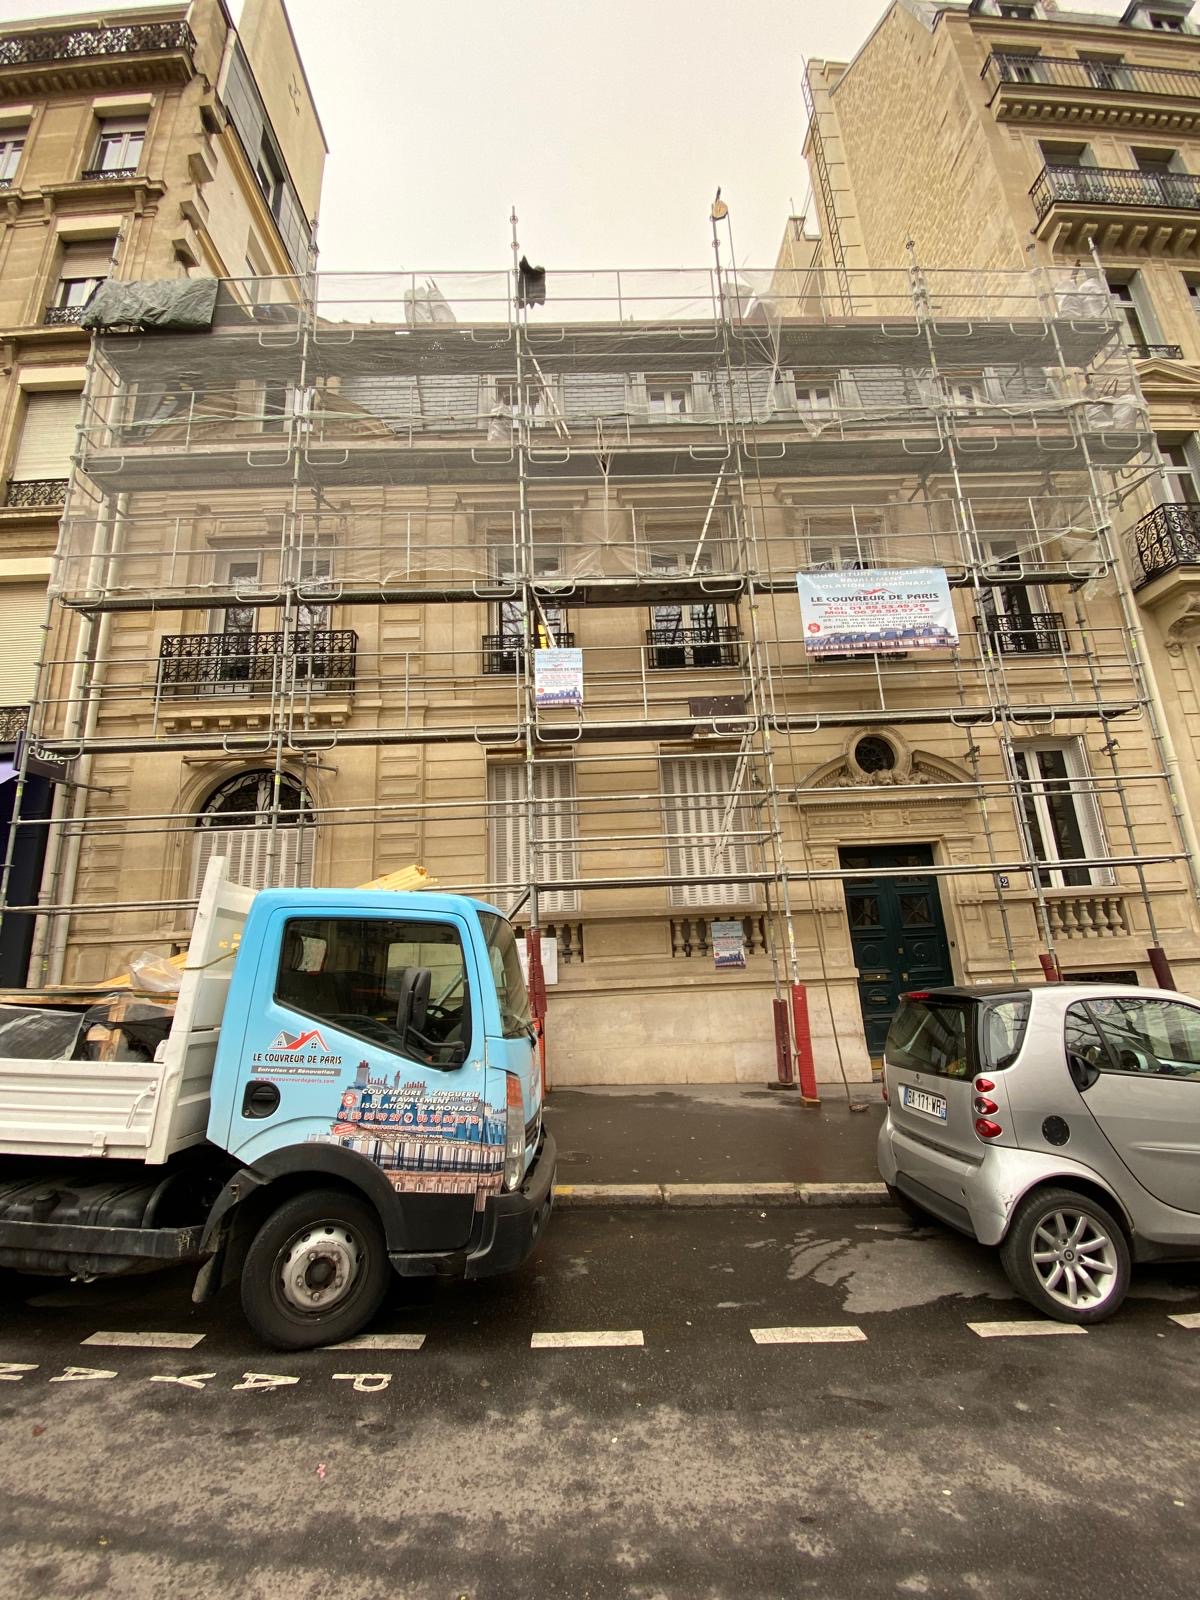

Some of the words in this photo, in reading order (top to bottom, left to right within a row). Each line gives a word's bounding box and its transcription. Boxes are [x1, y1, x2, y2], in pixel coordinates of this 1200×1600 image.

[253, 1053, 261, 1061] LE
[264, 1053, 305, 1063] COUVREUR
[307, 1055, 317, 1063] DE
[320, 1056, 342, 1064] PARIS
[362, 1088, 422, 1096] COUVERTURE
[390, 1096, 451, 1104] RAVALEMENT
[361, 1102, 412, 1110] ISOLATION
